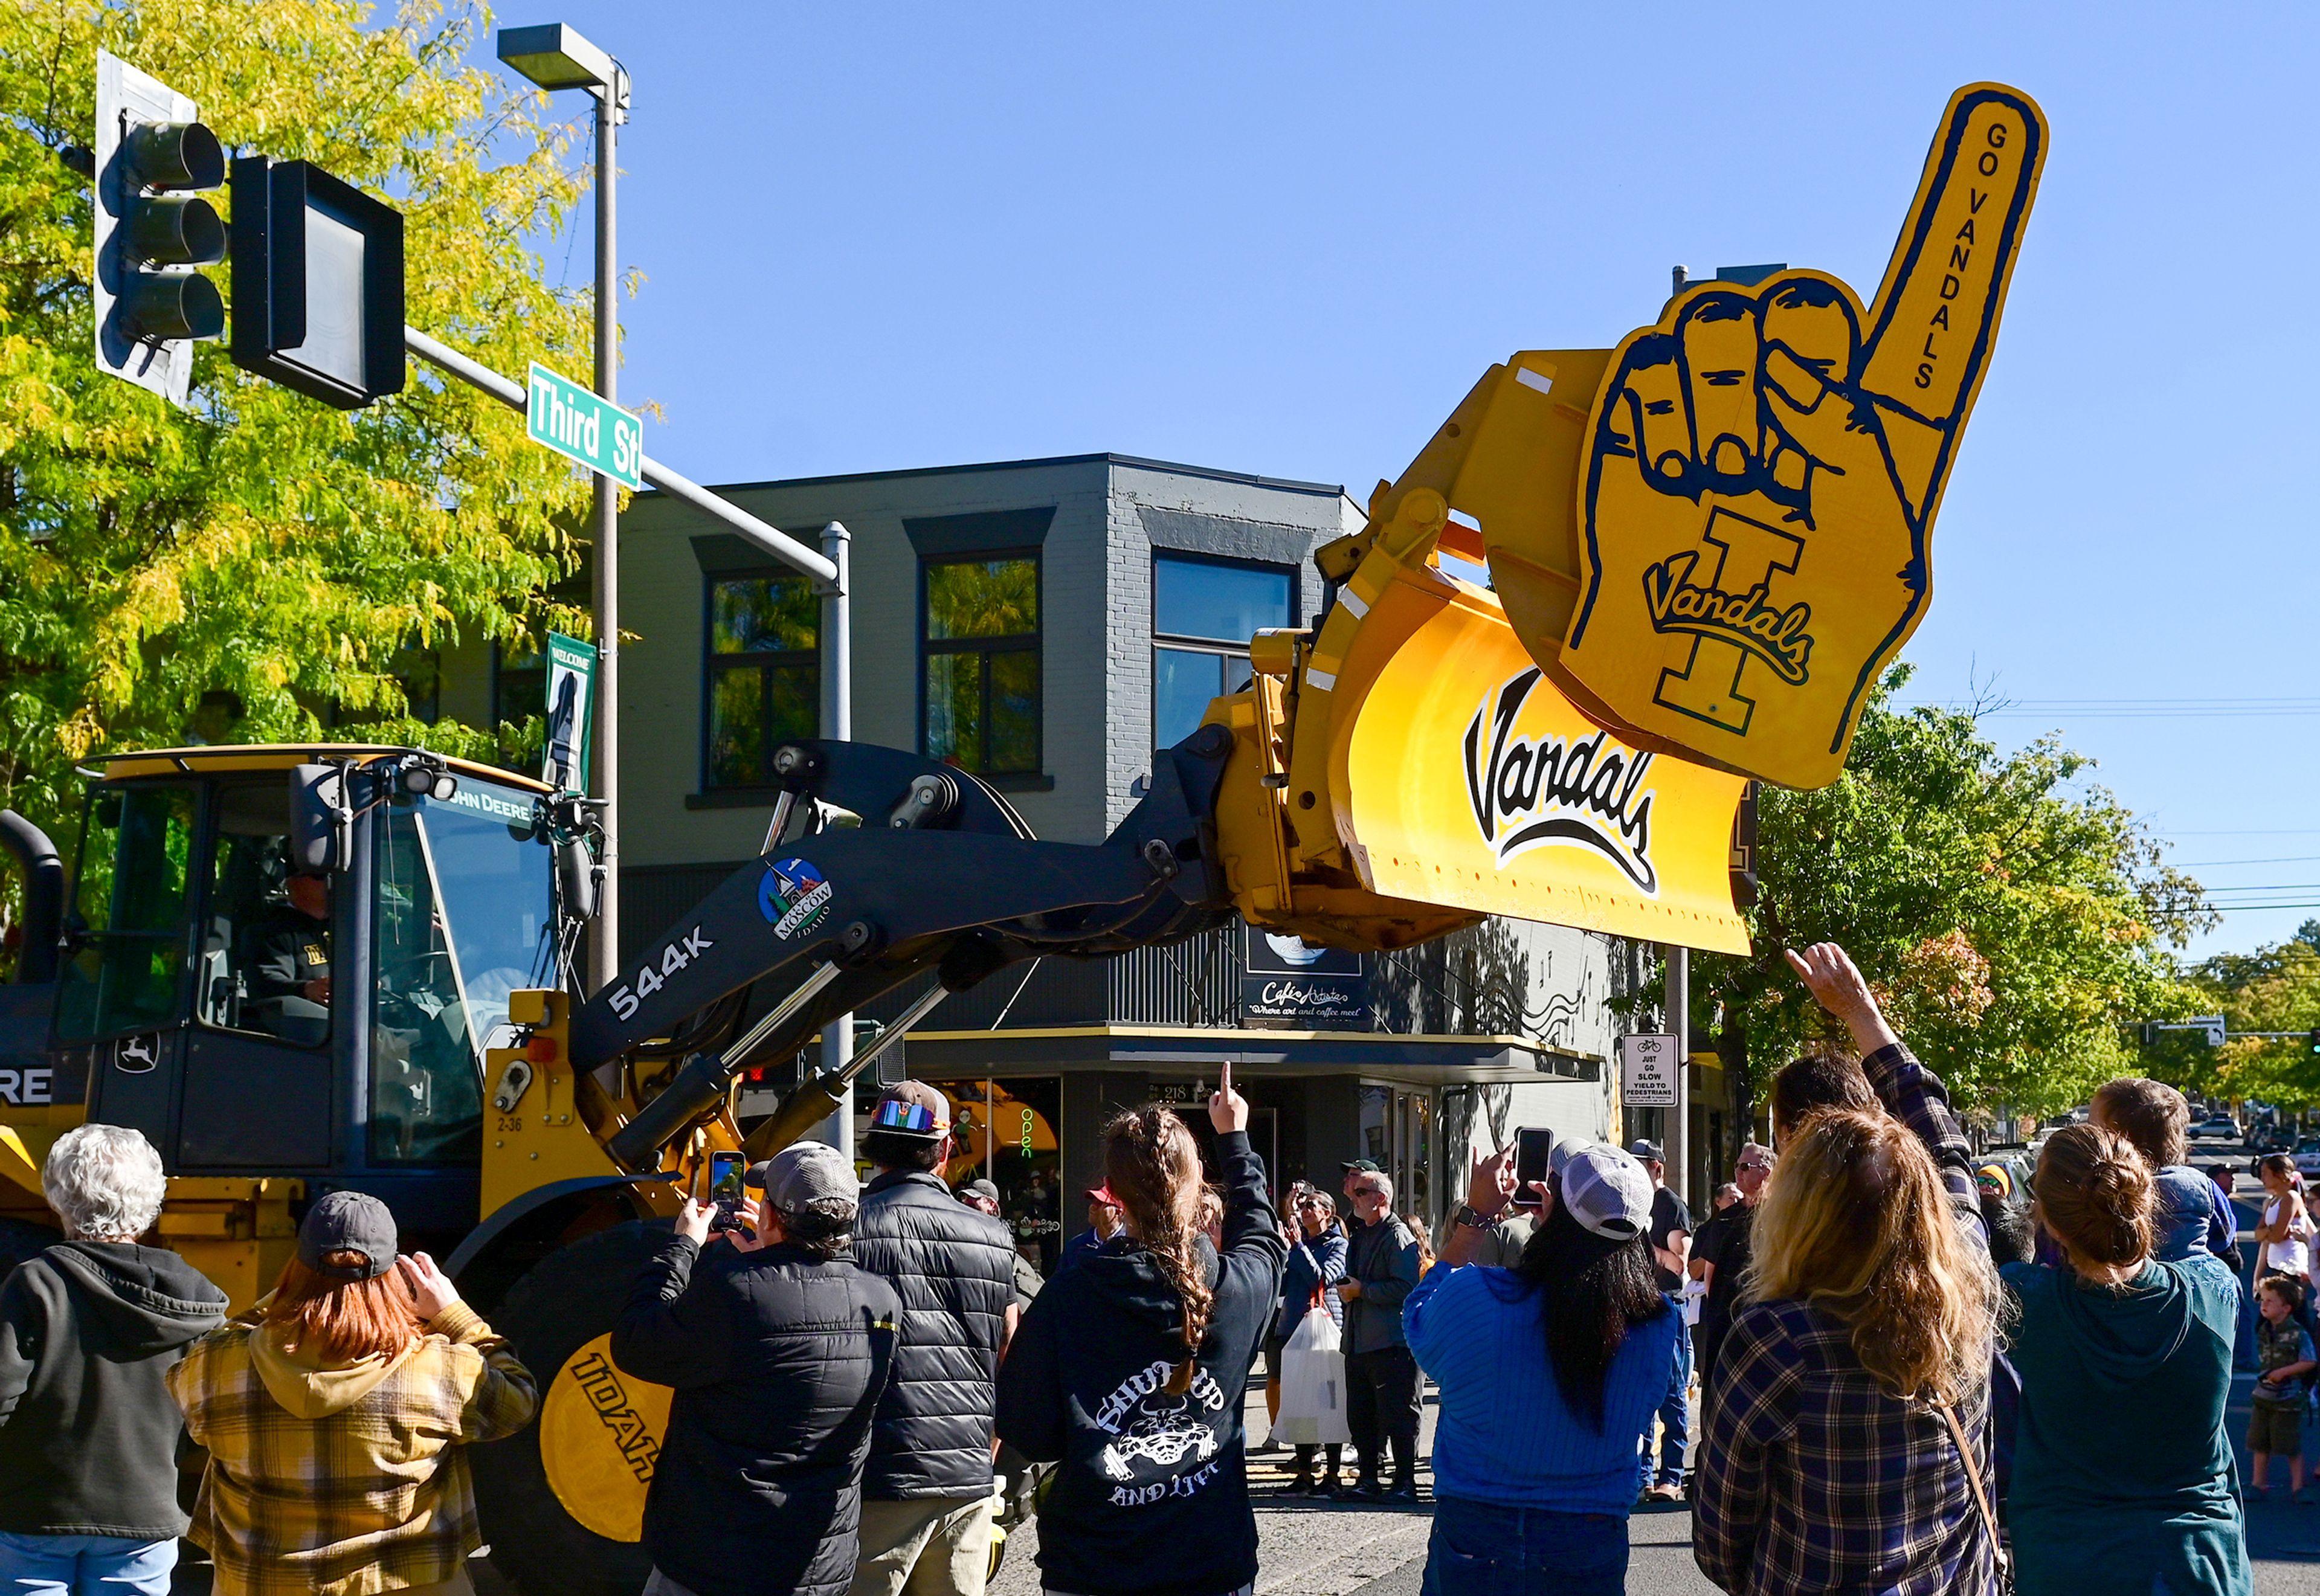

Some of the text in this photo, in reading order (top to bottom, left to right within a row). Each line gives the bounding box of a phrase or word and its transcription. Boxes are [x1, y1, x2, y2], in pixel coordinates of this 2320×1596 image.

[1914, 123, 2008, 389] GO VANDALS
[532, 374, 639, 480] Third St
[1642, 550, 1814, 671] Vandals
[551, 646, 590, 671] WELCOME
[1463, 664, 1654, 870] Vandals
[450, 790, 531, 822] OHN DEERE
[778, 886, 830, 938] MOSCOW
[796, 906, 830, 939] IDAHO
[608, 925, 714, 1022] 544K
[1316, 1006, 1339, 1017] coffee
[0, 1069, 53, 1103] RE
[1164, 1086, 1186, 1099] 218
[497, 1117, 522, 1131] 2-36
[570, 1353, 660, 1483] IDAH
[1096, 1360, 1224, 1435] SHUT UP
[1107, 1459, 1221, 1506] AND LIFT
